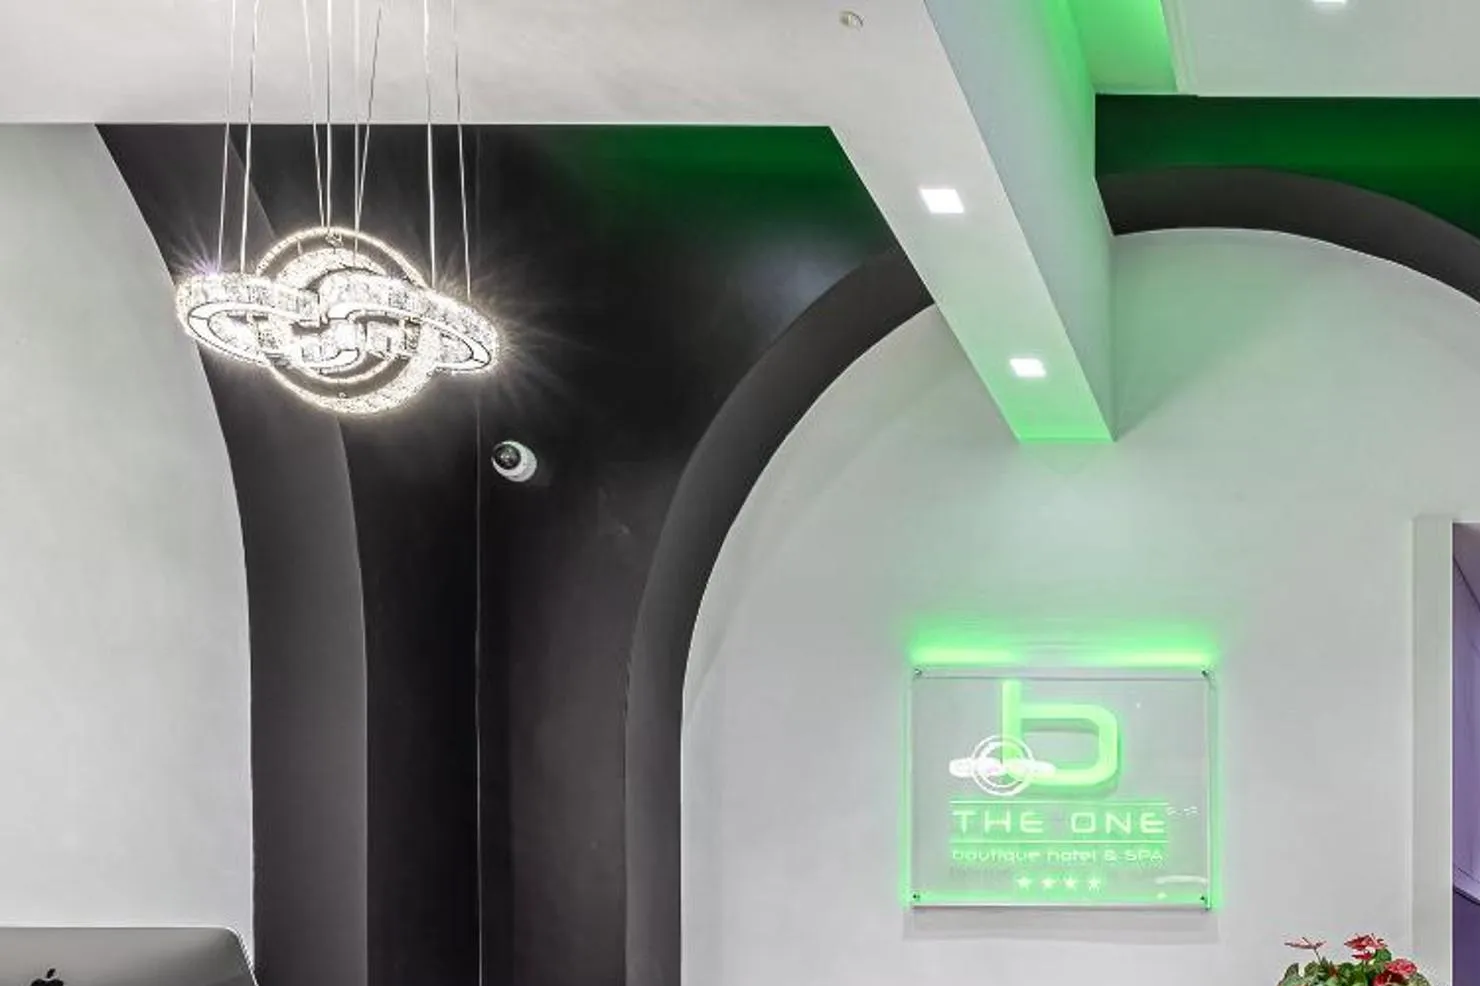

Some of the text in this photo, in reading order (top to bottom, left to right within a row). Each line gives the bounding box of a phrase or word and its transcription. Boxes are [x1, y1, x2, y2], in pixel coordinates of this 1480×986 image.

[952, 809, 1165, 834] THE ONE
[952, 848, 1164, 864] boutique hotel & SPA
